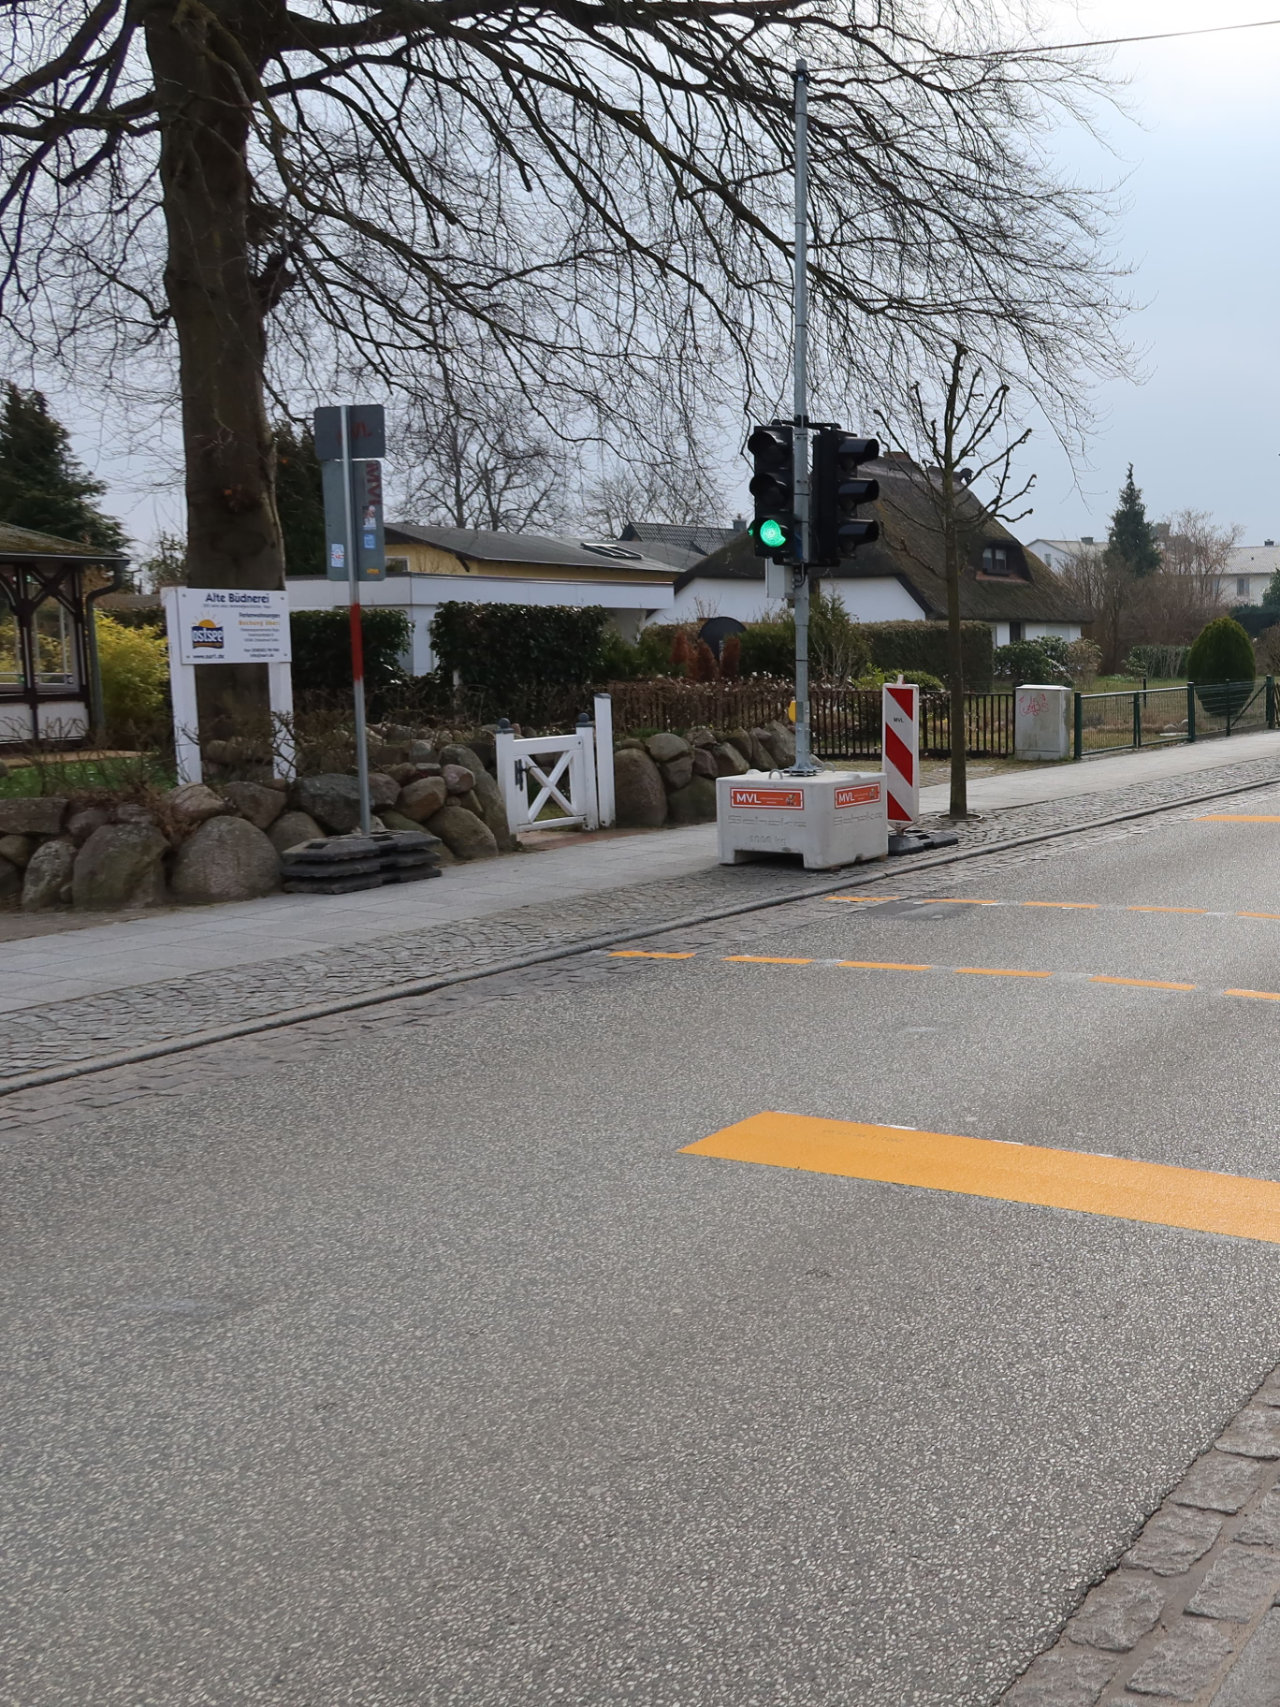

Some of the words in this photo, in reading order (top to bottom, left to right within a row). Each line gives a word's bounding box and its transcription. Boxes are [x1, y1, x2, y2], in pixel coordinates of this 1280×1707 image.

[206, 593, 226, 602] Alte
[229, 593, 269, 603] Büdnerei
[737, 793, 762, 804] MVL
[839, 793, 855, 803] MVL
